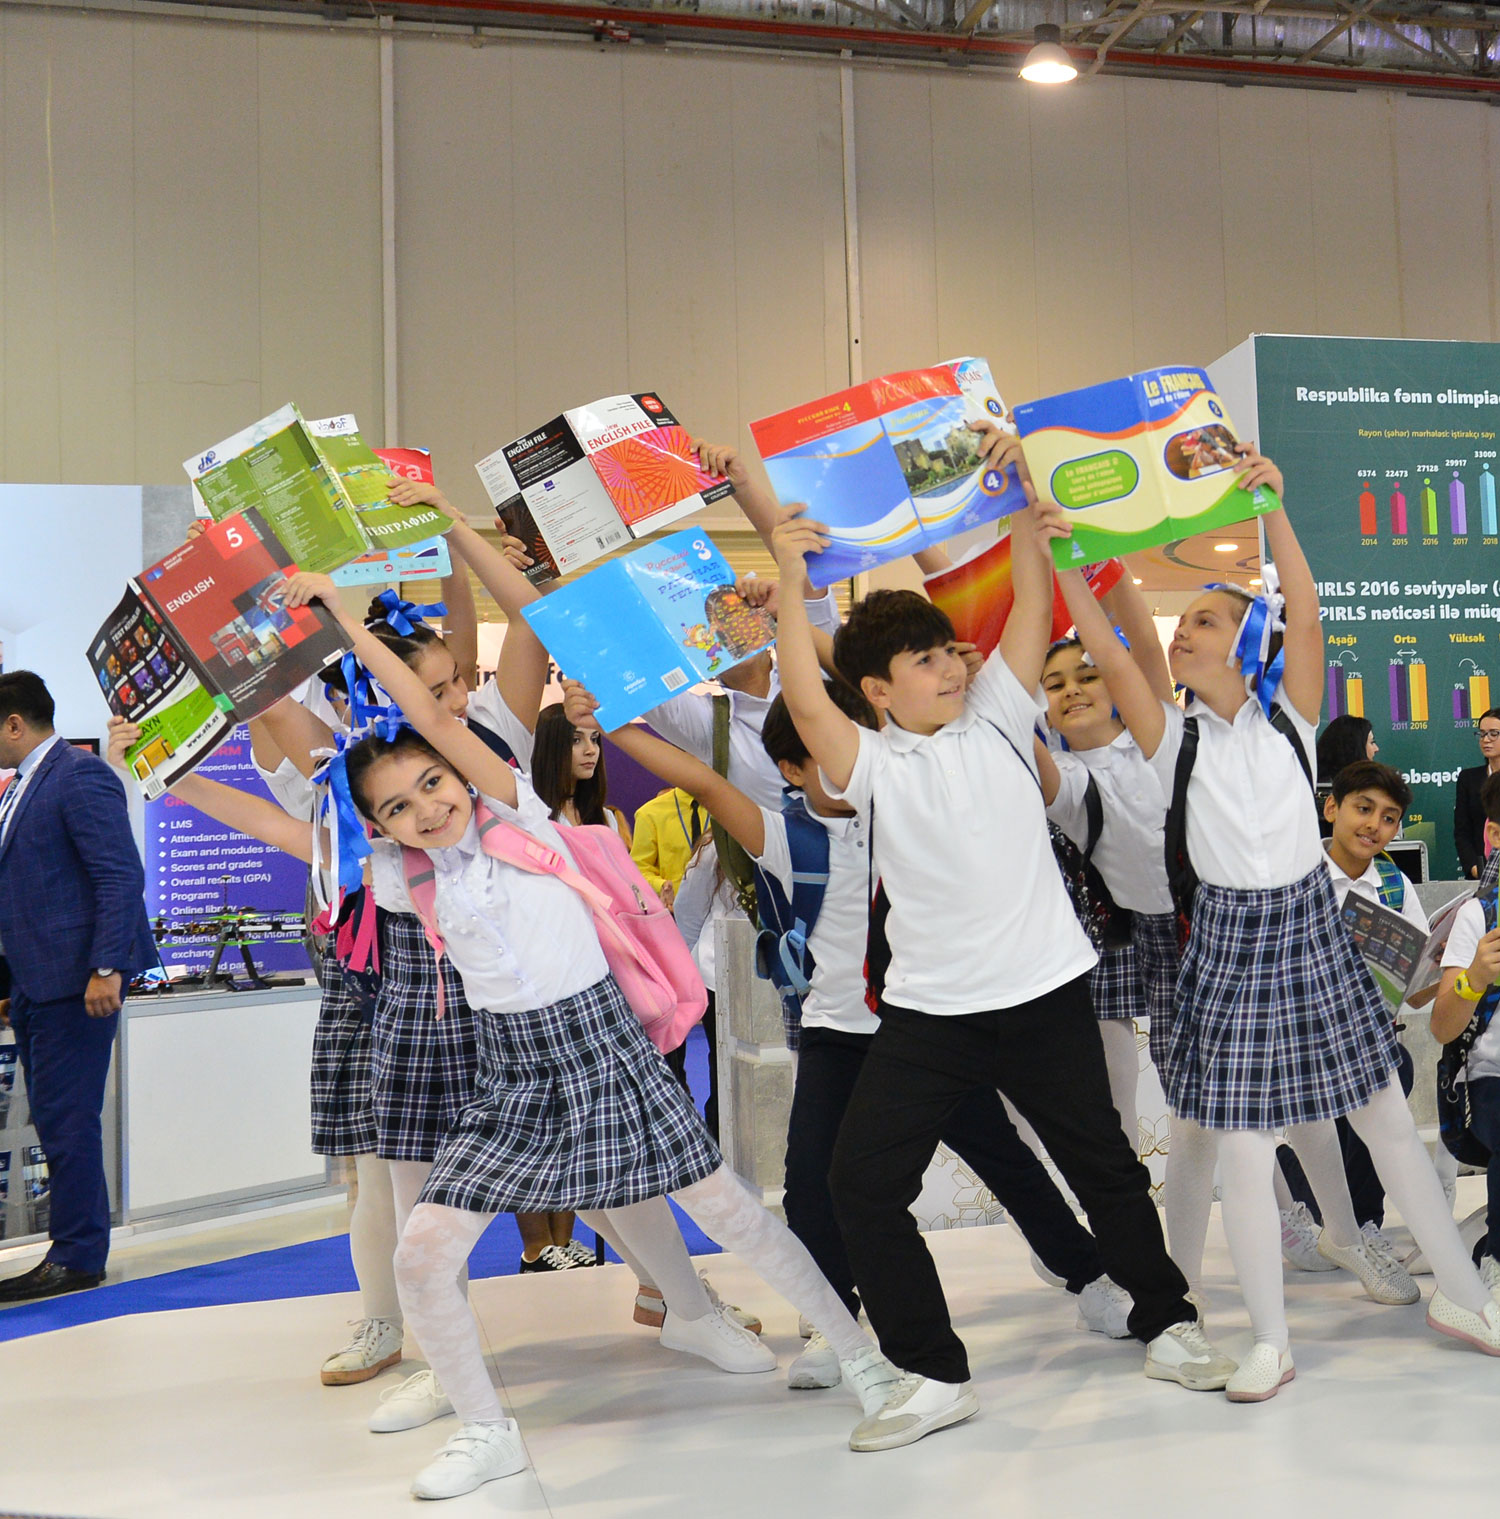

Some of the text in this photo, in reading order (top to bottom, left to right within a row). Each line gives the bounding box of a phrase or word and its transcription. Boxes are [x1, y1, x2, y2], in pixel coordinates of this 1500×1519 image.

[1142, 379, 1161, 399] Le
[1296, 386, 1390, 406] Respublika
[1394, 388, 1432, 403] fənn
[842, 401, 852, 412] 4
[988, 401, 1000, 414] 3
[587, 426, 631, 450] ENGLISH
[633, 419, 653, 433] FILE
[1358, 429, 1496, 440] Rayon (şəhər) mərhələsi: iştirakçı sayı
[507, 439, 534, 458] ENGLISH
[533, 431, 548, 445] FILE
[1474, 451, 1497, 459] 33000
[1445, 459, 1467, 468] 29917
[1357, 470, 1377, 478] 6374
[1385, 470, 1409, 478] 22473
[1416, 465, 1439, 473] 27128
[986, 472, 1000, 489] 4
[225, 527, 243, 548] 5
[1361, 538, 1378, 546] 2014
[1392, 538, 1409, 546] 2015
[1422, 538, 1439, 546] 2016
[1452, 538, 1469, 546] 2017
[1482, 537, 1499, 545] 2018
[692, 539, 712, 561] 3
[165, 575, 216, 614] ENGLISH
[1361, 581, 1399, 596] 2016
[1404, 580, 1487, 600] səviyyələr
[1371, 605, 1435, 621] nəticəsi
[1440, 604, 1459, 619] ilə
[111, 627, 126, 643] TEST
[1394, 635, 1417, 644] Orta
[1449, 633, 1485, 644] Yüksək
[1328, 635, 1357, 647] Aşağı
[1473, 669, 1486, 677] 16%
[1454, 683, 1465, 691] 9%
[1392, 722, 1408, 730] 2011
[1410, 721, 1428, 730] 2016
[1454, 721, 1470, 729] 2011
[1409, 814, 1422, 822] 520
[170, 820, 193, 829] LMS
[170, 834, 228, 844] Attendance
[170, 846, 264, 859] Exam and modules
[171, 860, 263, 872] Scores and grades
[171, 873, 271, 887] Overall (GPA)
[171, 892, 219, 903] Programs
[171, 906, 204, 916] Online
